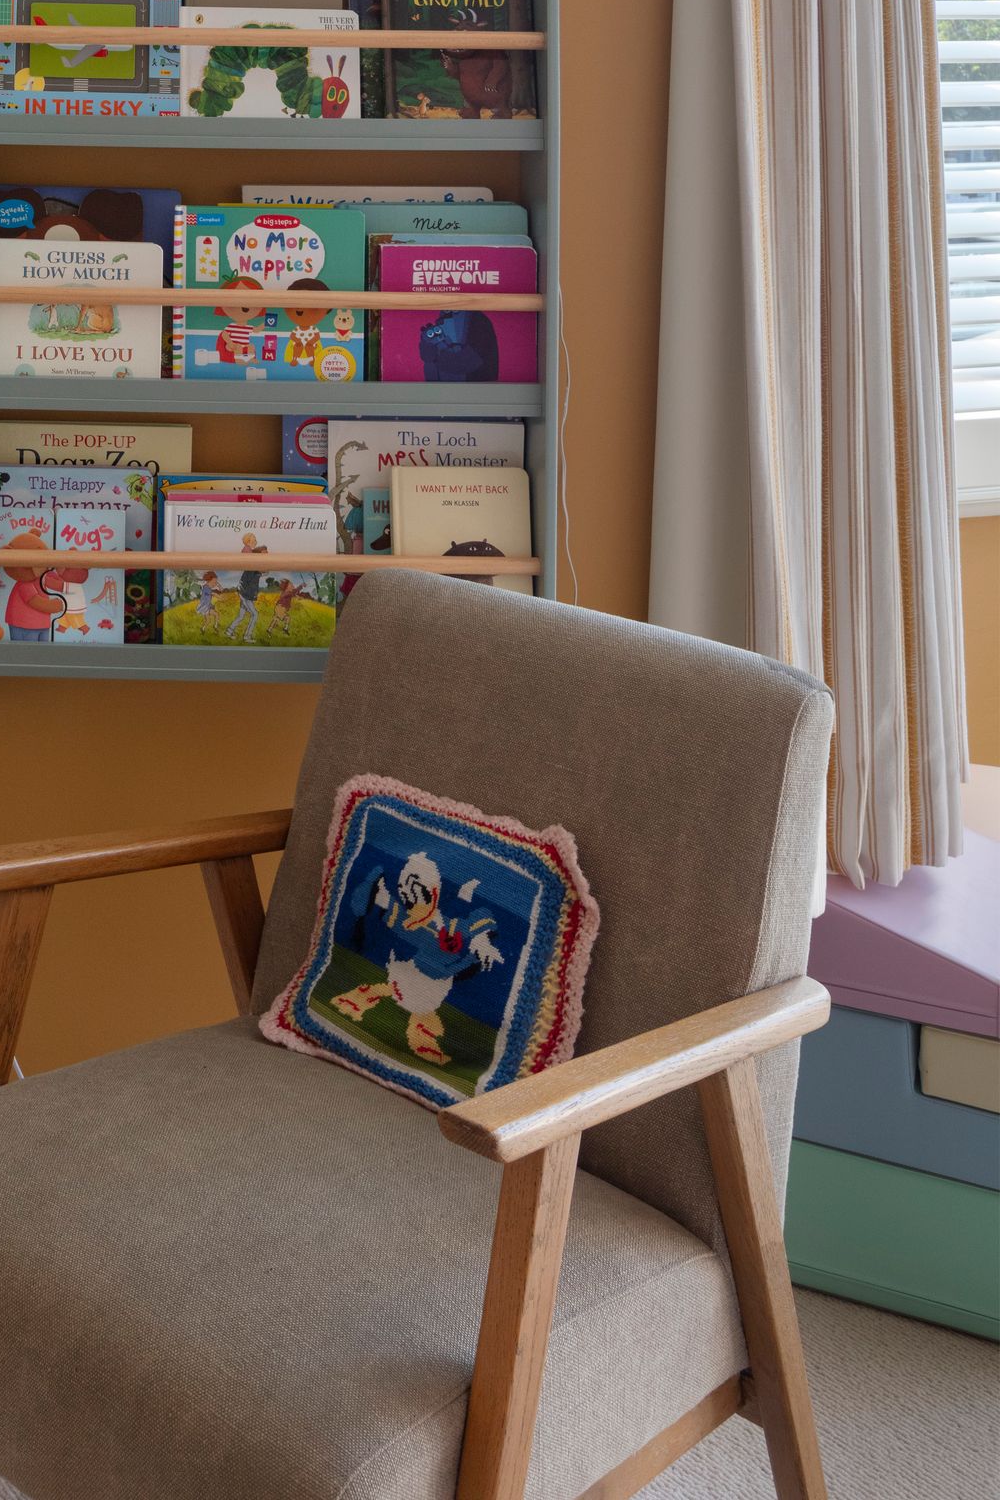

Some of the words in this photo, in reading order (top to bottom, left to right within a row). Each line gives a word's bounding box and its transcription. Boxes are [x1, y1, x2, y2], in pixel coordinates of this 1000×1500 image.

[336, 17, 354, 25] VERY
[25, 98, 47, 115] IN
[52, 99, 94, 116] THE
[100, 100, 143, 116] SKY
[1, 205, 25, 217] Squeak
[413, 217, 461, 231] Milo's
[235, 233, 258, 251] No
[266, 232, 319, 252] More
[47, 250, 105, 265] GUESS
[239, 255, 313, 281] Nappies
[413, 260, 480, 271] GOODNIGHT
[22, 266, 67, 279] HOW
[73, 267, 130, 281] MUCH
[412, 271, 500, 285] EVERYONE
[16, 345, 23, 360] I
[31, 346, 85, 361] LOVE
[90, 348, 134, 363] YOU
[265, 352, 274, 360] M
[40, 433, 69, 448] The
[73, 434, 136, 449] POP-UP
[398, 431, 431, 446] The
[436, 432, 477, 447] Loch
[435, 453, 508, 467] Monster
[29, 476, 57, 490] The
[60, 477, 106, 493] Happy
[421, 485, 446, 493] WANT
[449, 485, 464, 493] MY
[466, 485, 483, 493] HAT
[486, 486, 509, 494] BACK
[10, 515, 51, 534] Daddy
[177, 514, 205, 528] We're
[209, 514, 241, 532] Going
[245, 519, 257, 528] on
[260, 520, 267, 529] a
[269, 517, 296, 530] Bear
[299, 517, 328, 530] Hunt
[61, 524, 114, 551] Hugs
